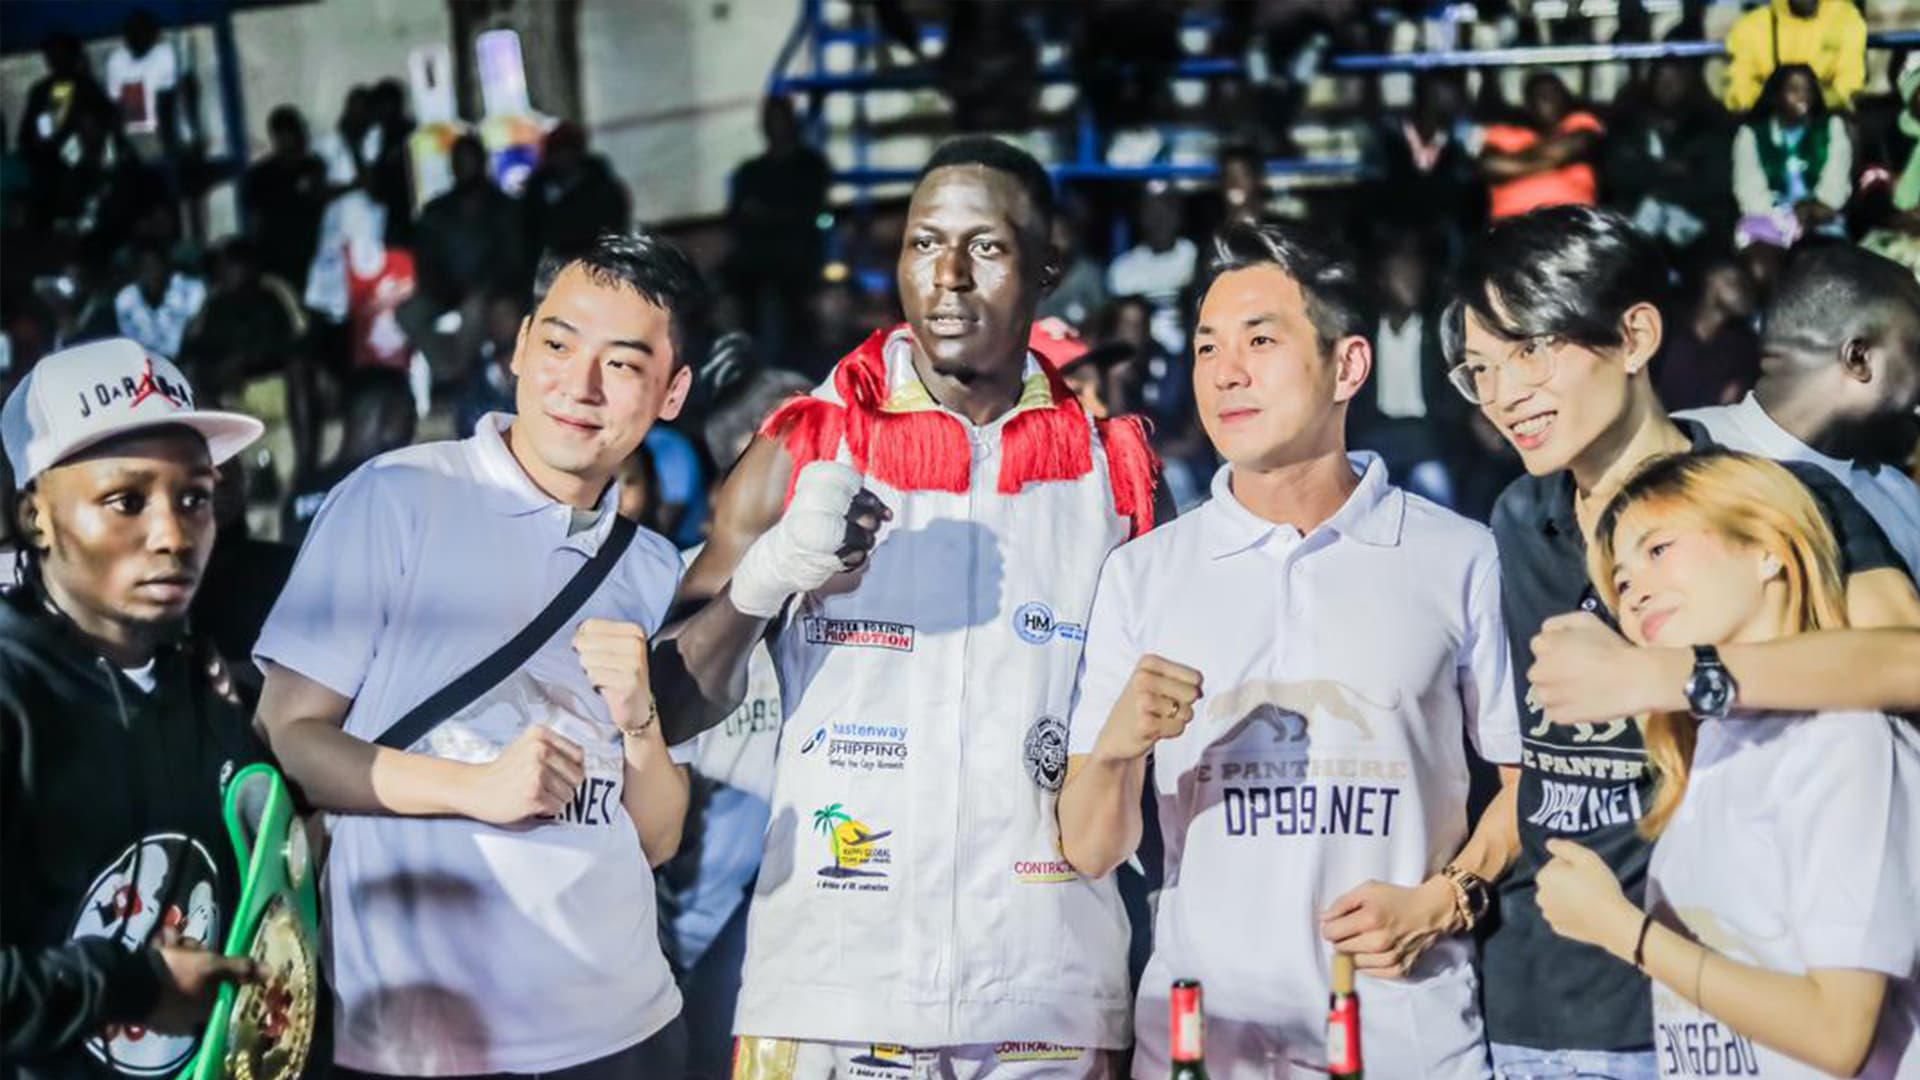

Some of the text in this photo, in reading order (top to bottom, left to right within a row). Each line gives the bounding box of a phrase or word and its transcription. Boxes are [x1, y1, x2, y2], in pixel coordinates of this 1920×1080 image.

[1025, 613, 1050, 632] HM
[825, 631, 910, 647] PROMOTION
[829, 742, 908, 757] SHIPPING
[1197, 759, 1408, 782] E PANTHERE
[1523, 751, 1645, 780] E PANTH
[557, 777, 616, 825] .NET
[1223, 786, 1401, 836] DP99.NET
